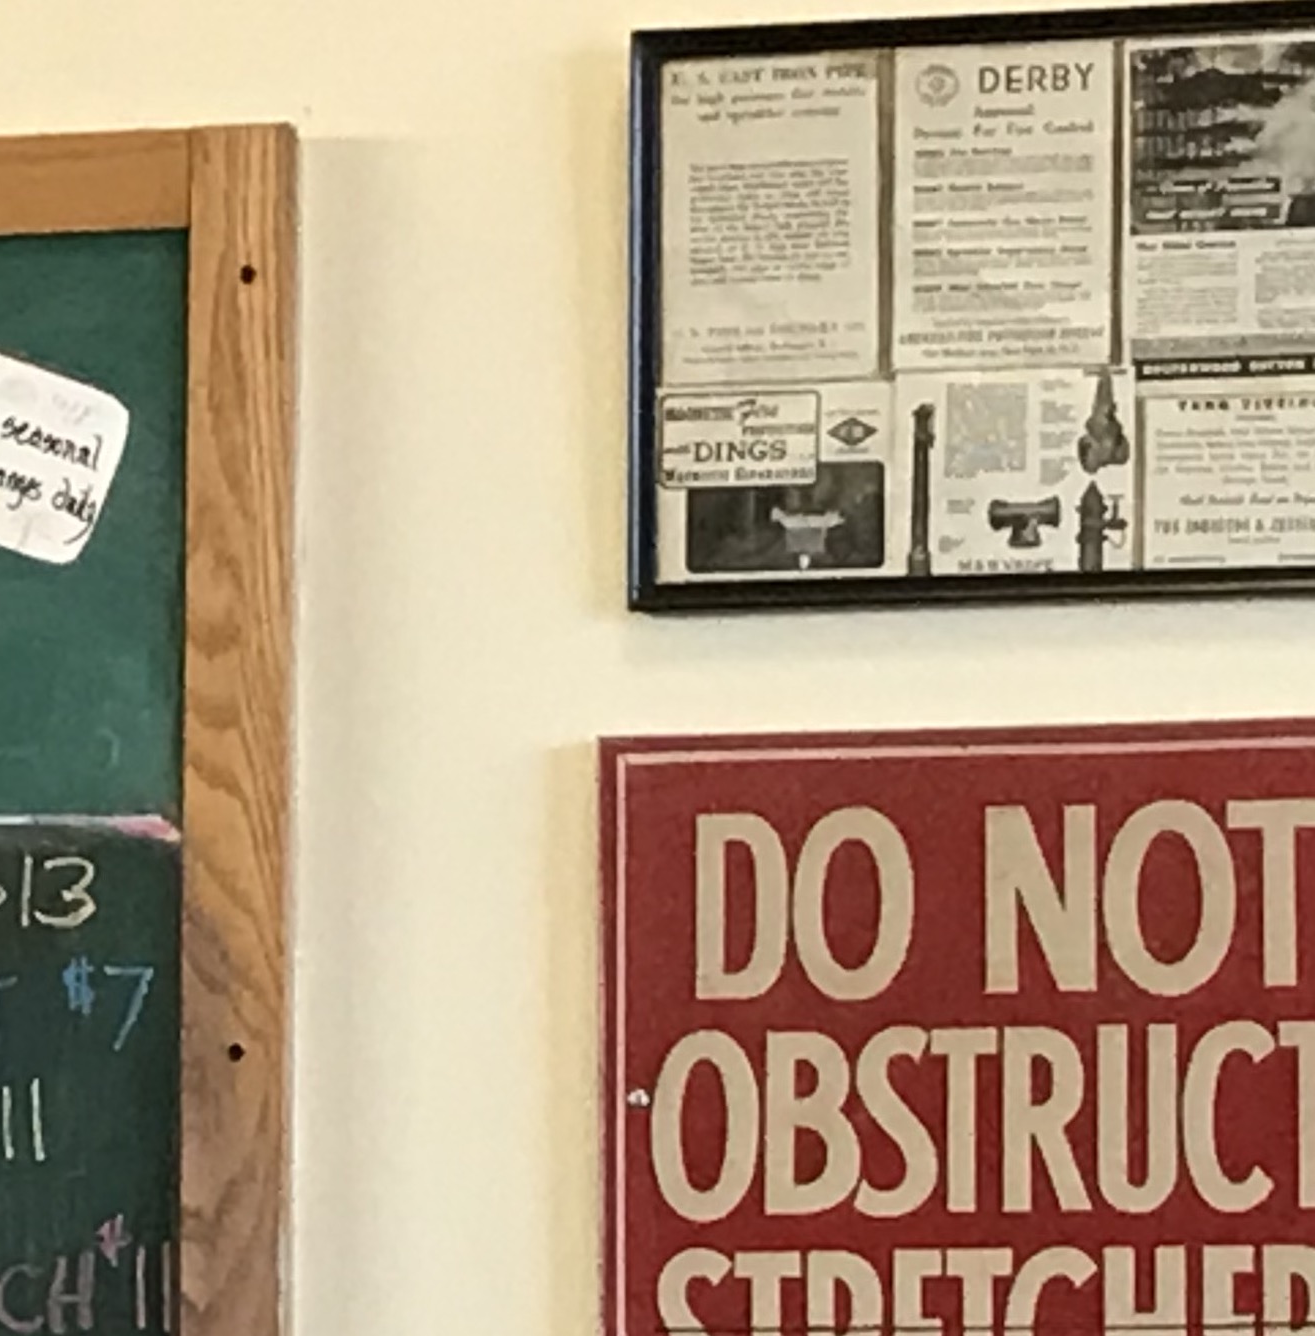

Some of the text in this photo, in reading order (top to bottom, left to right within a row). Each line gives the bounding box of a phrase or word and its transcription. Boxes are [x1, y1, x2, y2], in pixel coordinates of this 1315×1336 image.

[978, 62, 1095, 94] DERBY
[0, 416, 102, 472] seasonal
[693, 439, 787, 463] DINGS
[695, 798, 1315, 1001] DO NOT
[60, 954, 154, 1052] $7
[651, 1020, 1315, 1223] OBSTRUCT
